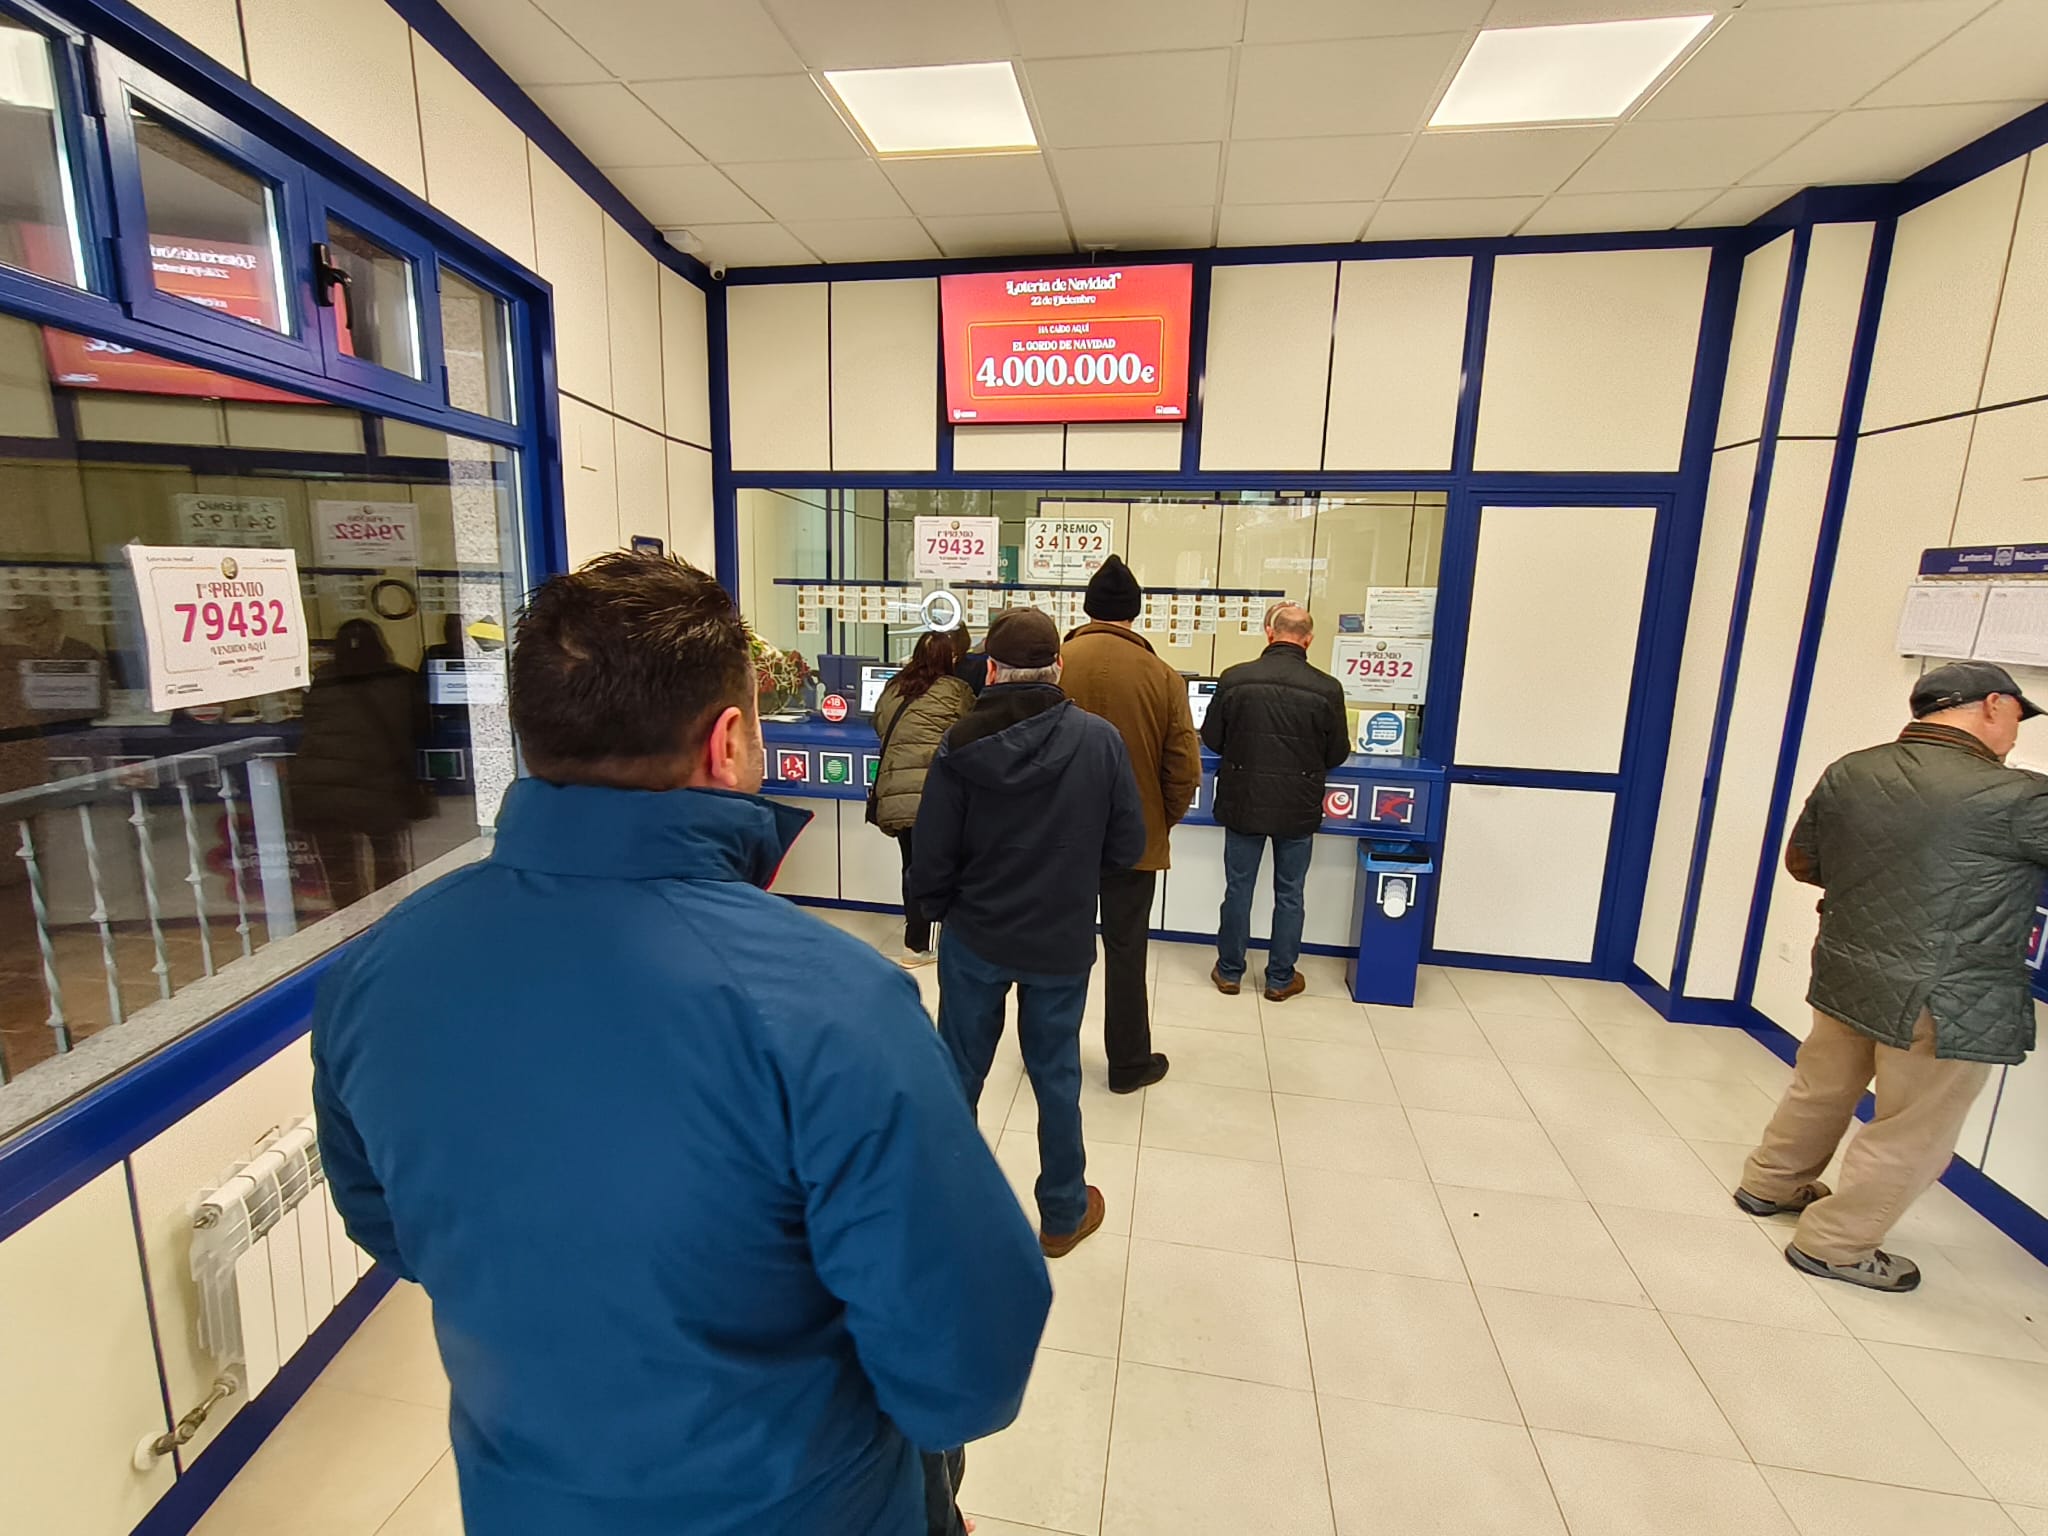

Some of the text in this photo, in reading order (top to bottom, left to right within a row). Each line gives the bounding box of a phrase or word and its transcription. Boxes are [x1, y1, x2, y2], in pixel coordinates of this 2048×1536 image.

[1051, 277, 1067, 292] de
[1067, 272, 1121, 291] Navidad
[1030, 294, 1096, 307] 22 de Diciembre
[1012, 338, 1117, 352] EL GORDO DE NAVIDAD
[1040, 524, 1098, 533] 2 PREMIO
[926, 538, 985, 555] 79432
[208, 582, 264, 599] PREMIO
[174, 599, 288, 643] 79432
[210, 644, 247, 655] VENDIDO
[1346, 659, 1414, 678] 79432
